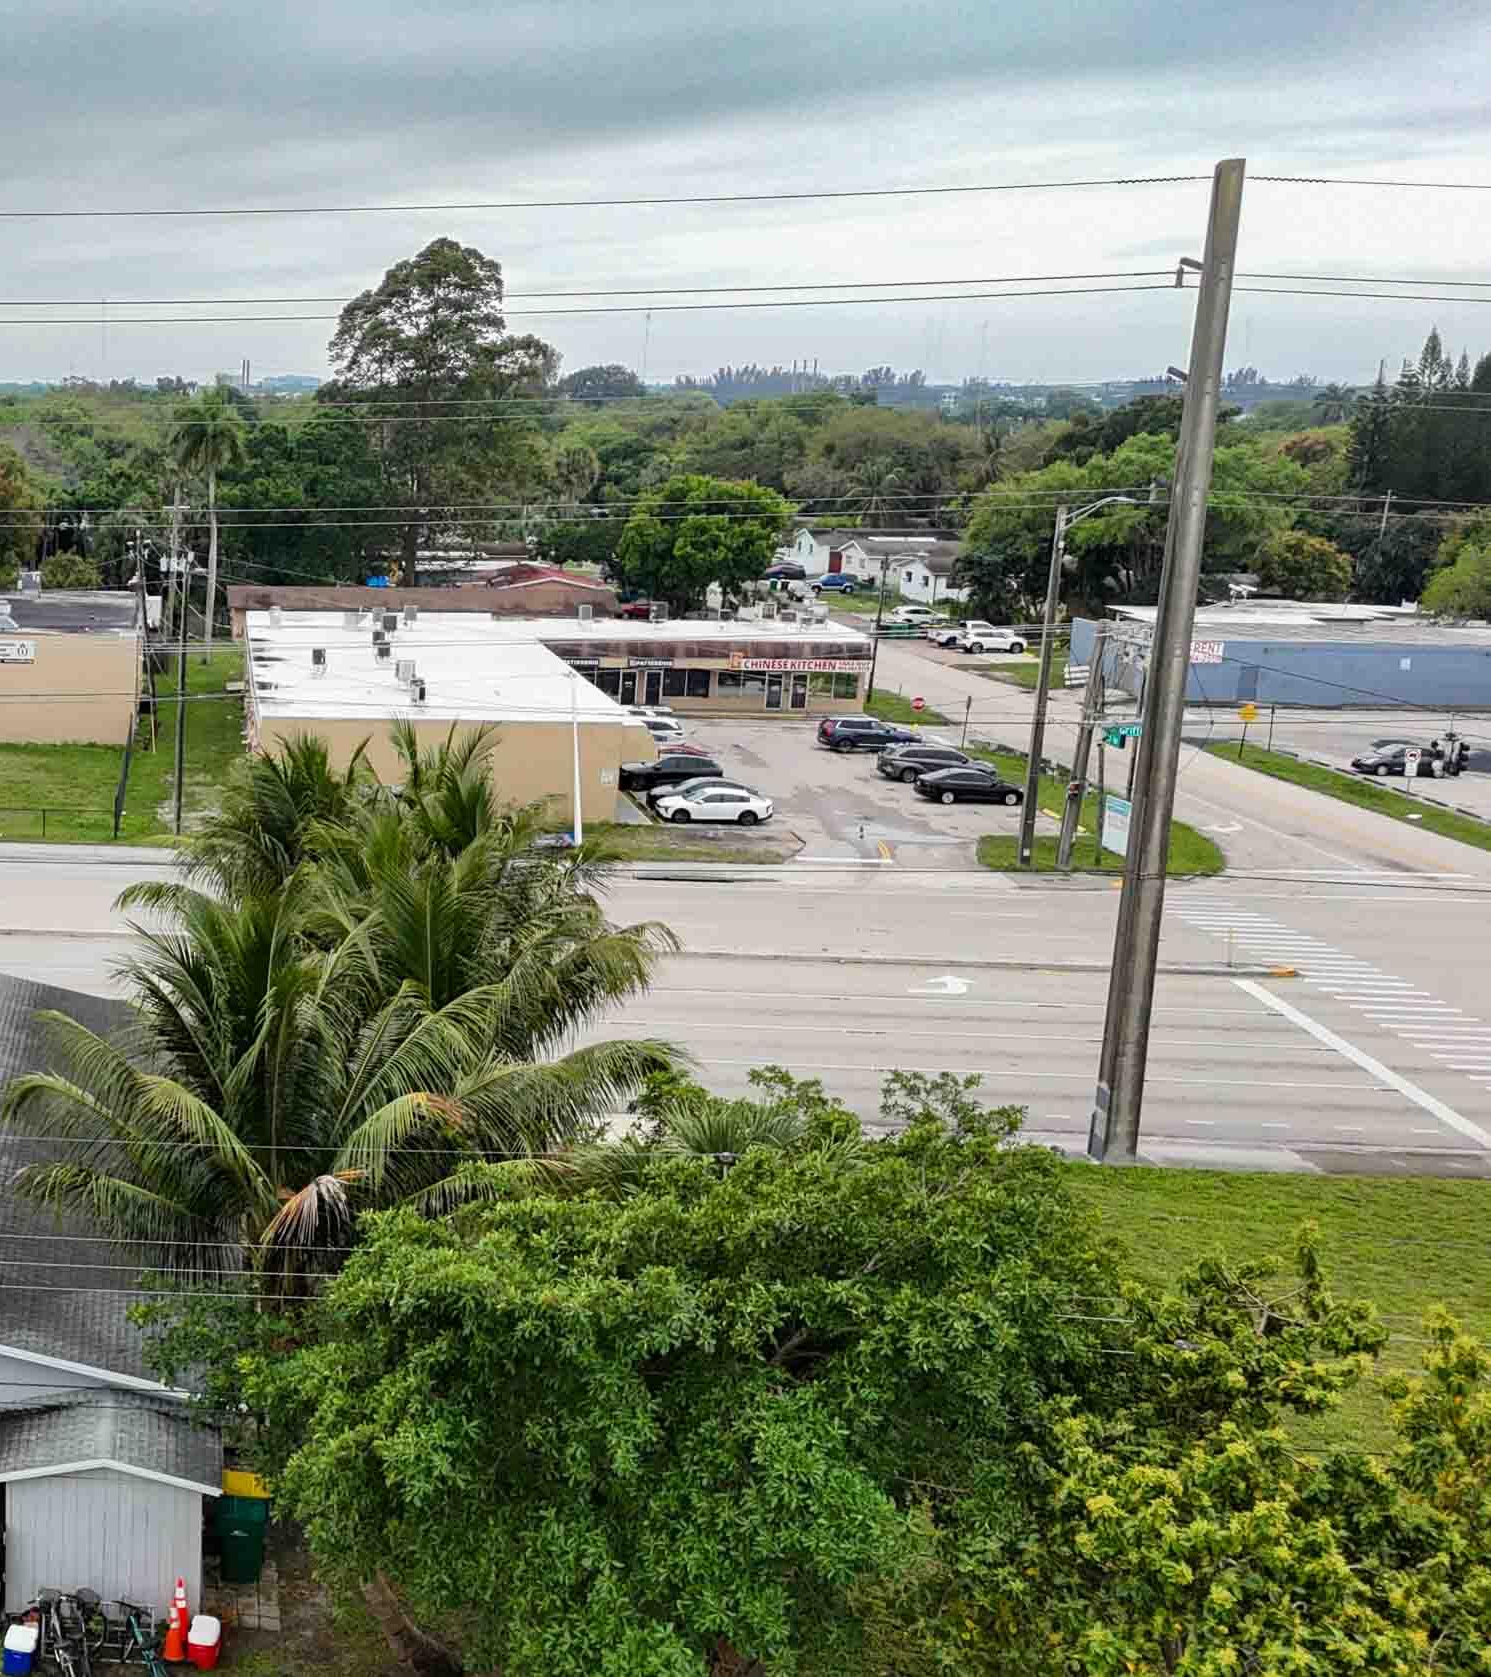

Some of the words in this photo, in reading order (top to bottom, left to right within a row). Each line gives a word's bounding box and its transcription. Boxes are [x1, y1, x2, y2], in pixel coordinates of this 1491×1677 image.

[1193, 641, 1222, 655] RENT
[743, 659, 788, 670] CHINESE
[790, 660, 837, 670] KITCHEN
